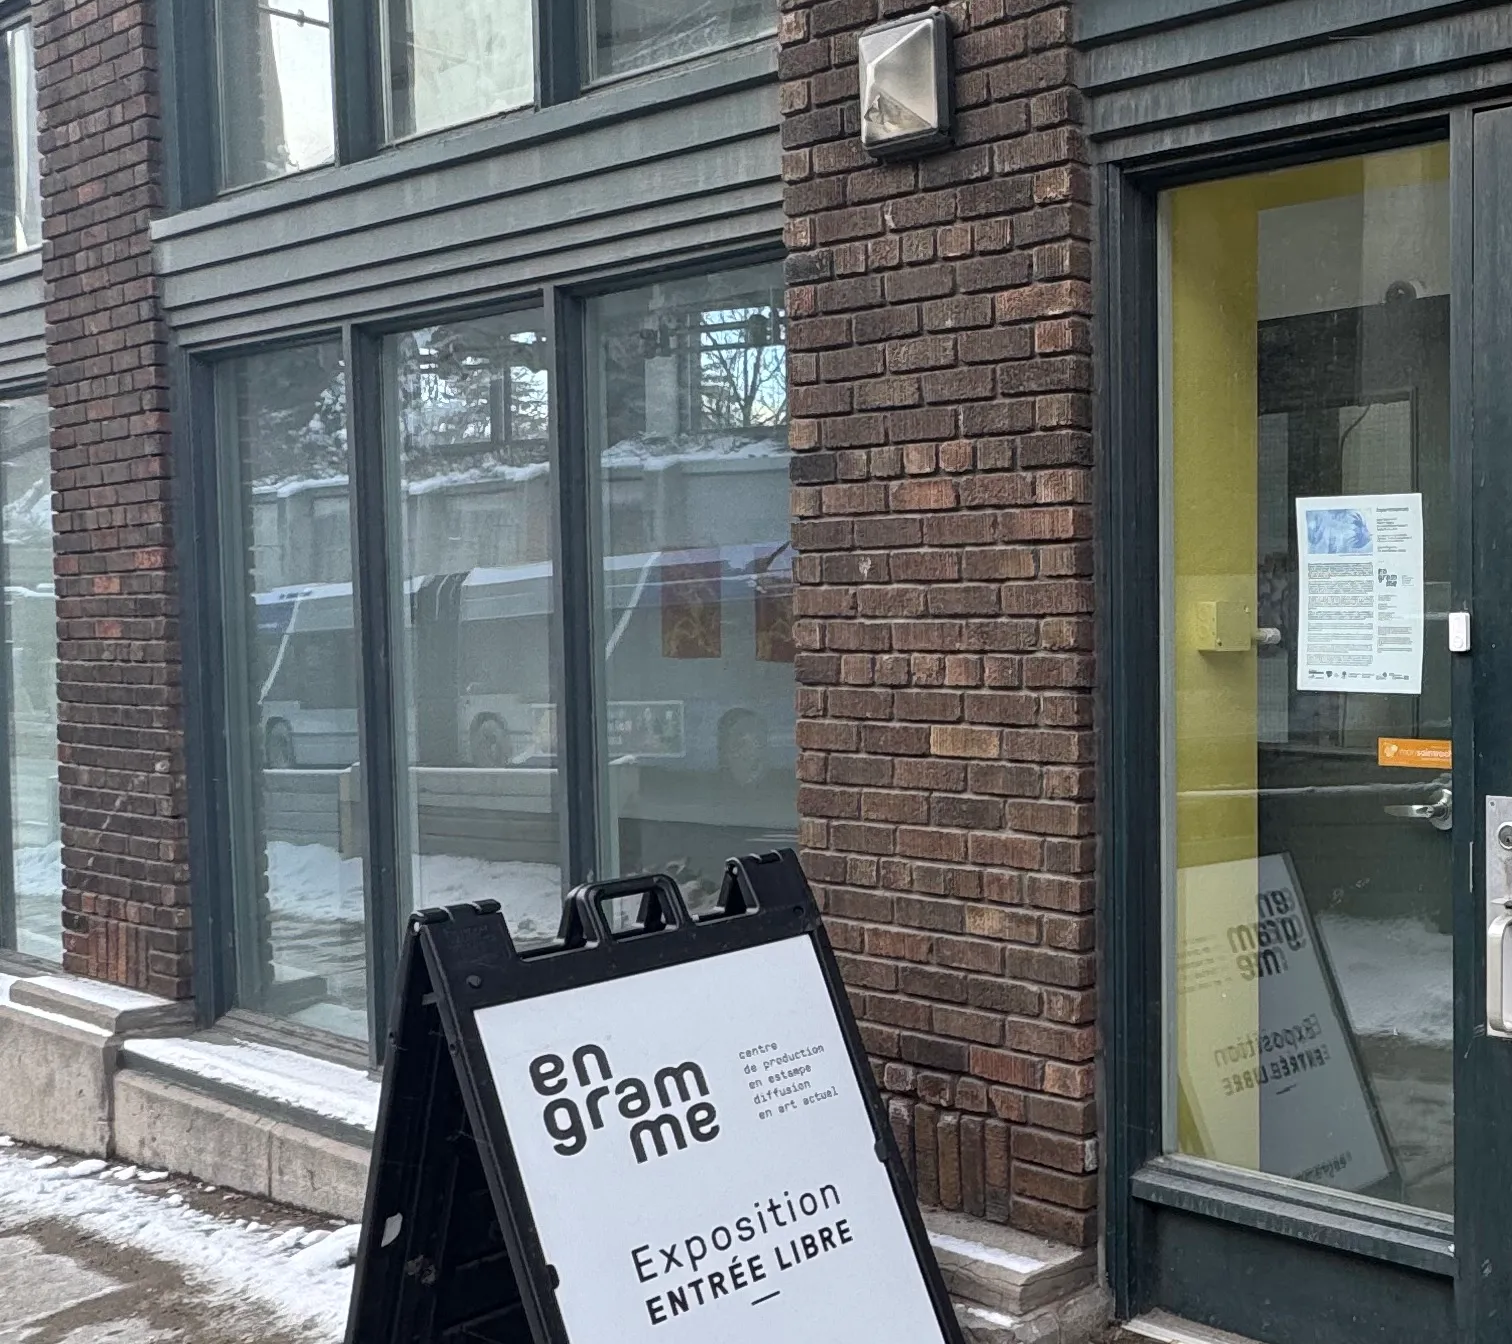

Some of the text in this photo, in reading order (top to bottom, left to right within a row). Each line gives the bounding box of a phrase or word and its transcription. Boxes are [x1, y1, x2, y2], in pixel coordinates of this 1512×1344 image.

[529, 1044, 613, 1096] en
[739, 1042, 778, 1060] centre
[743, 1044, 825, 1074] de production
[748, 1064, 812, 1089] en estampe
[753, 1080, 811, 1105] diffusion
[543, 1061, 710, 1156] gram
[758, 1085, 838, 1120] en art actuel
[629, 1102, 720, 1164] me
[631, 1184, 841, 1283] Exposition
[645, 1219, 853, 1325] ENTRÉE LIBRE
